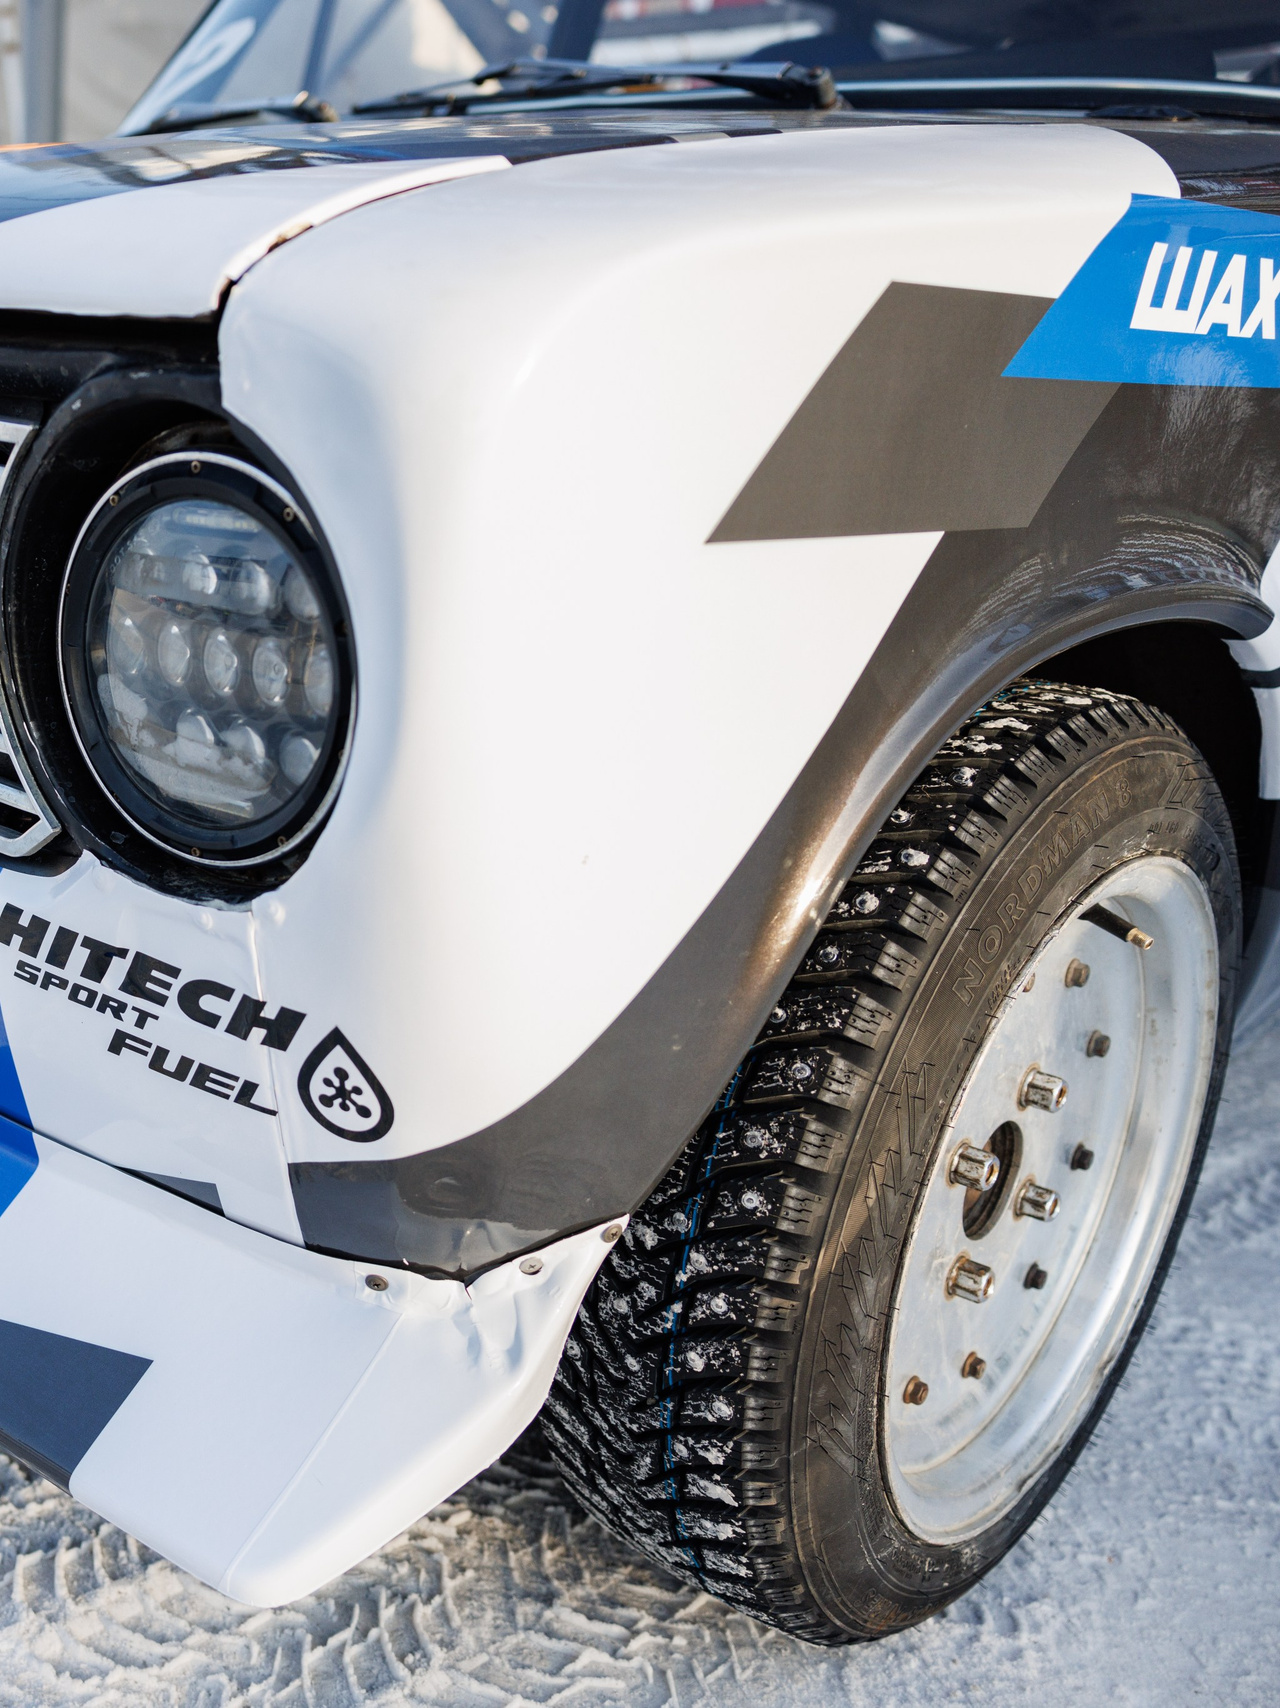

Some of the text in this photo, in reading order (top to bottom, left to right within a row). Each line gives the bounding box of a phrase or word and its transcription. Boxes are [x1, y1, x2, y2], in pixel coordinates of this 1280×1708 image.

[1129, 241, 1280, 340] ШАХ
[951, 790, 1111, 1007] NORDMAN
[1116, 778, 1132, 808] 8
[13, 959, 160, 1030] SPORT
[107, 1028, 278, 1117] FUEL
